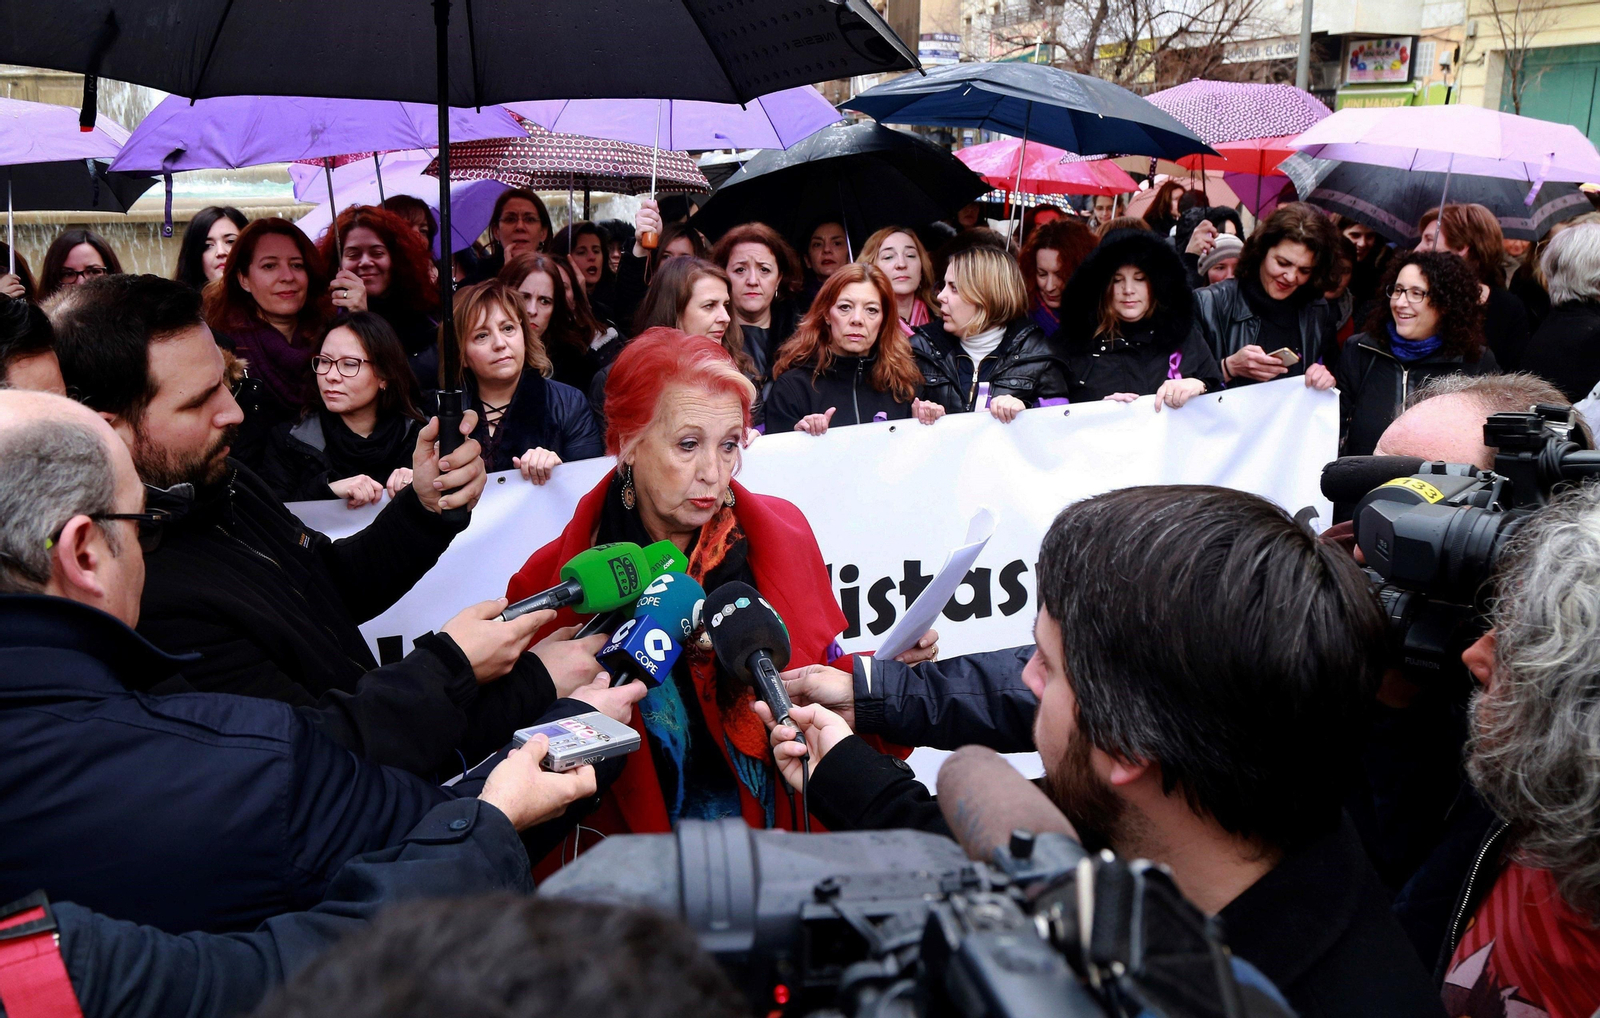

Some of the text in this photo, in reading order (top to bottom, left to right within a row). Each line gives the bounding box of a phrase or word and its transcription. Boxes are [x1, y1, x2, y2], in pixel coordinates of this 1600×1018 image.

[1342, 97, 1363, 108] MINI
[1365, 97, 1406, 108] MARKET
[1402, 479, 1438, 500] 133
[650, 553, 672, 573] anada
[616, 564, 629, 593] CERO
[636, 596, 661, 607] COPE
[826, 559, 1029, 639] istas
[634, 650, 659, 675] COPE
[1404, 656, 1441, 670] FUJINON
